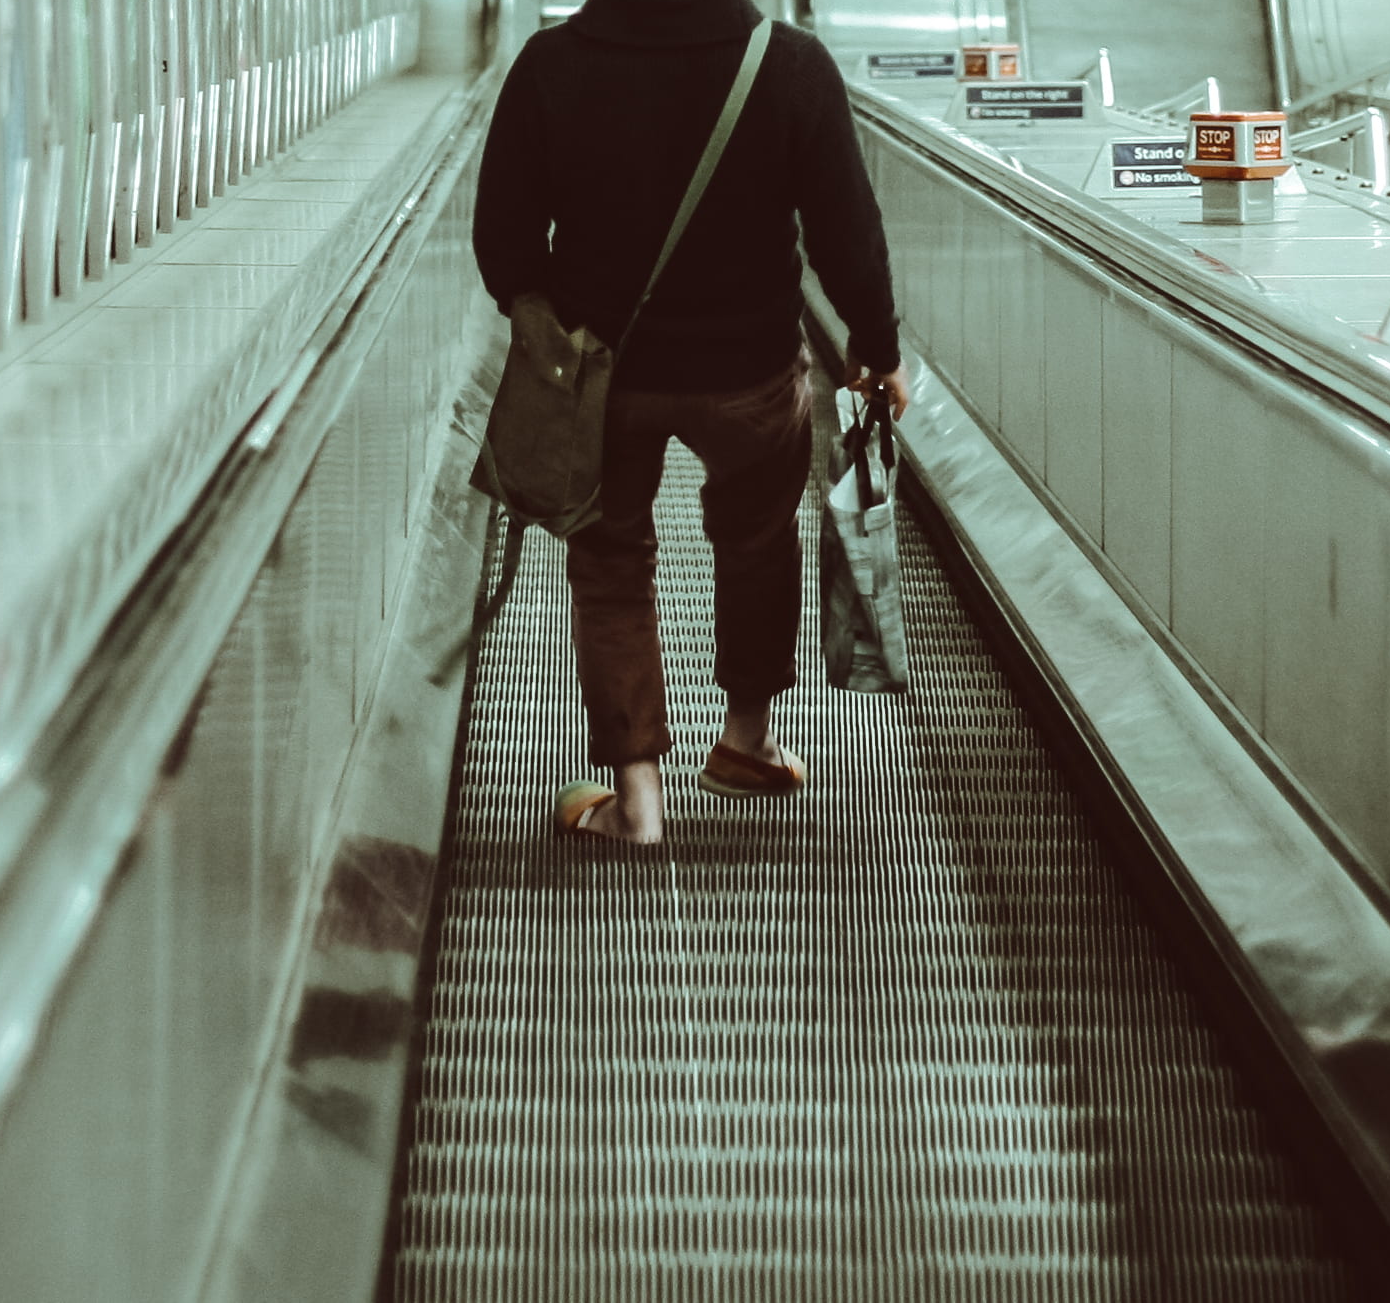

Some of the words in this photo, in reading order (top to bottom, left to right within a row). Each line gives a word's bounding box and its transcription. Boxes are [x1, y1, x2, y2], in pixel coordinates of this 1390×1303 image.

[1199, 130, 1231, 144] STOP
[1254, 129, 1280, 144] STOP
[1134, 147, 1172, 160] Stand
[1174, 150, 1185, 160] o
[1135, 172, 1152, 183] No
